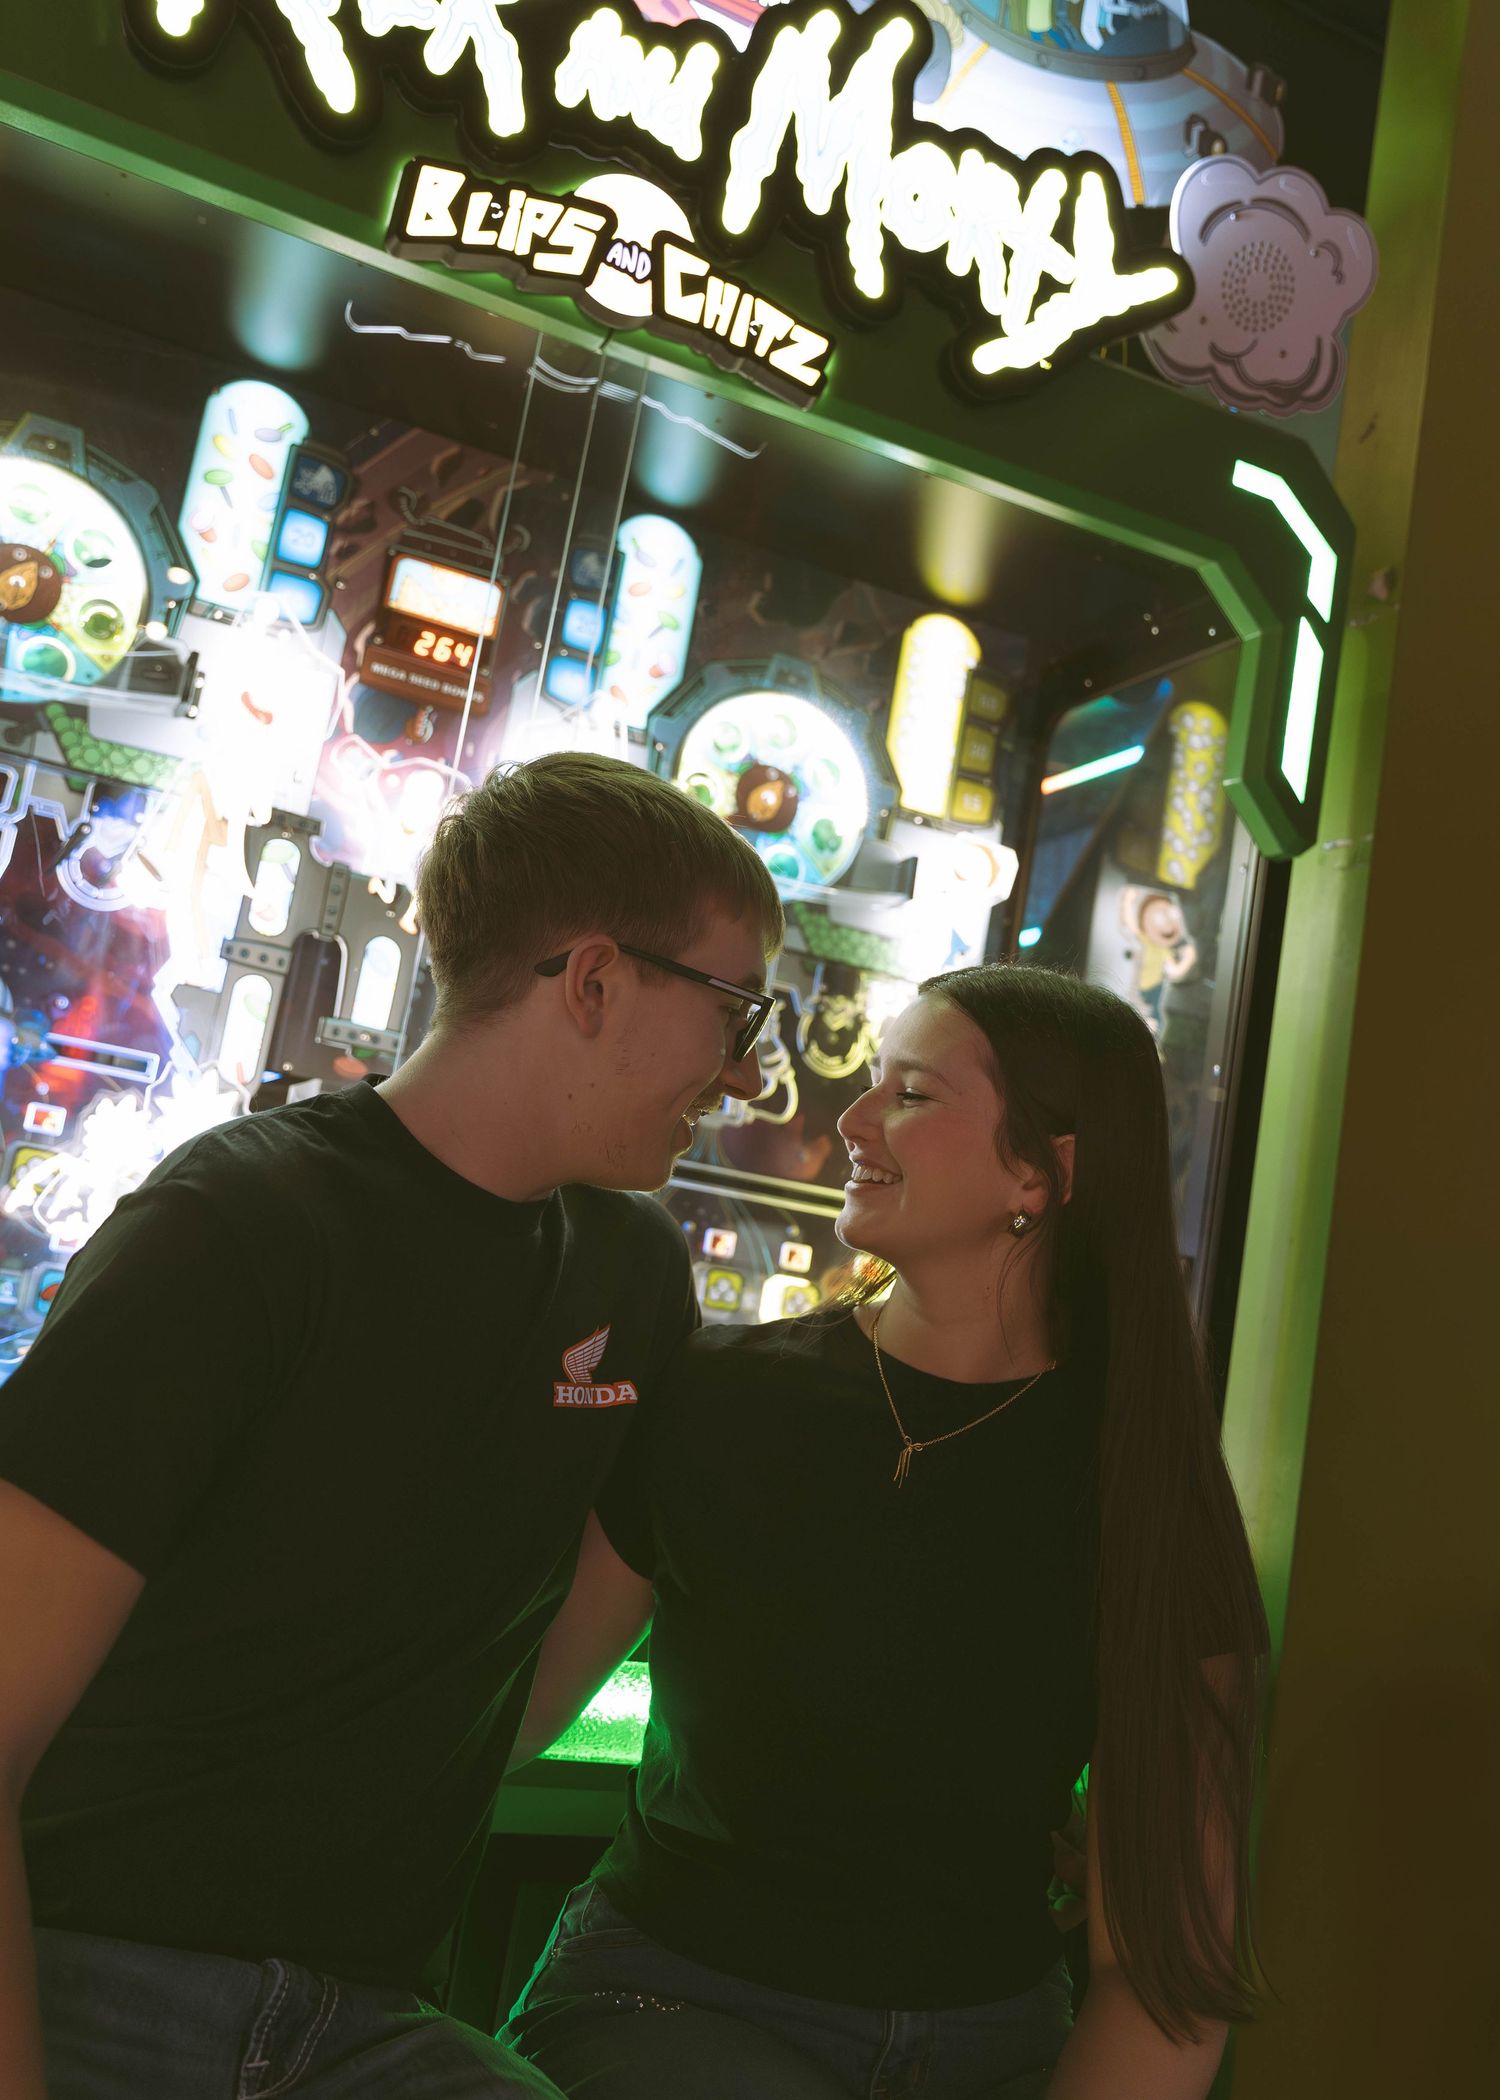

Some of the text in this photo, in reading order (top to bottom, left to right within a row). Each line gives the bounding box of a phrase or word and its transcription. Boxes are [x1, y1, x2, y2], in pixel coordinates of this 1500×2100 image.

[405, 164, 829, 387] BLIPS AND CHITZ
[413, 630, 474, 667] 264
[556, 1384, 639, 1405] HONDA
